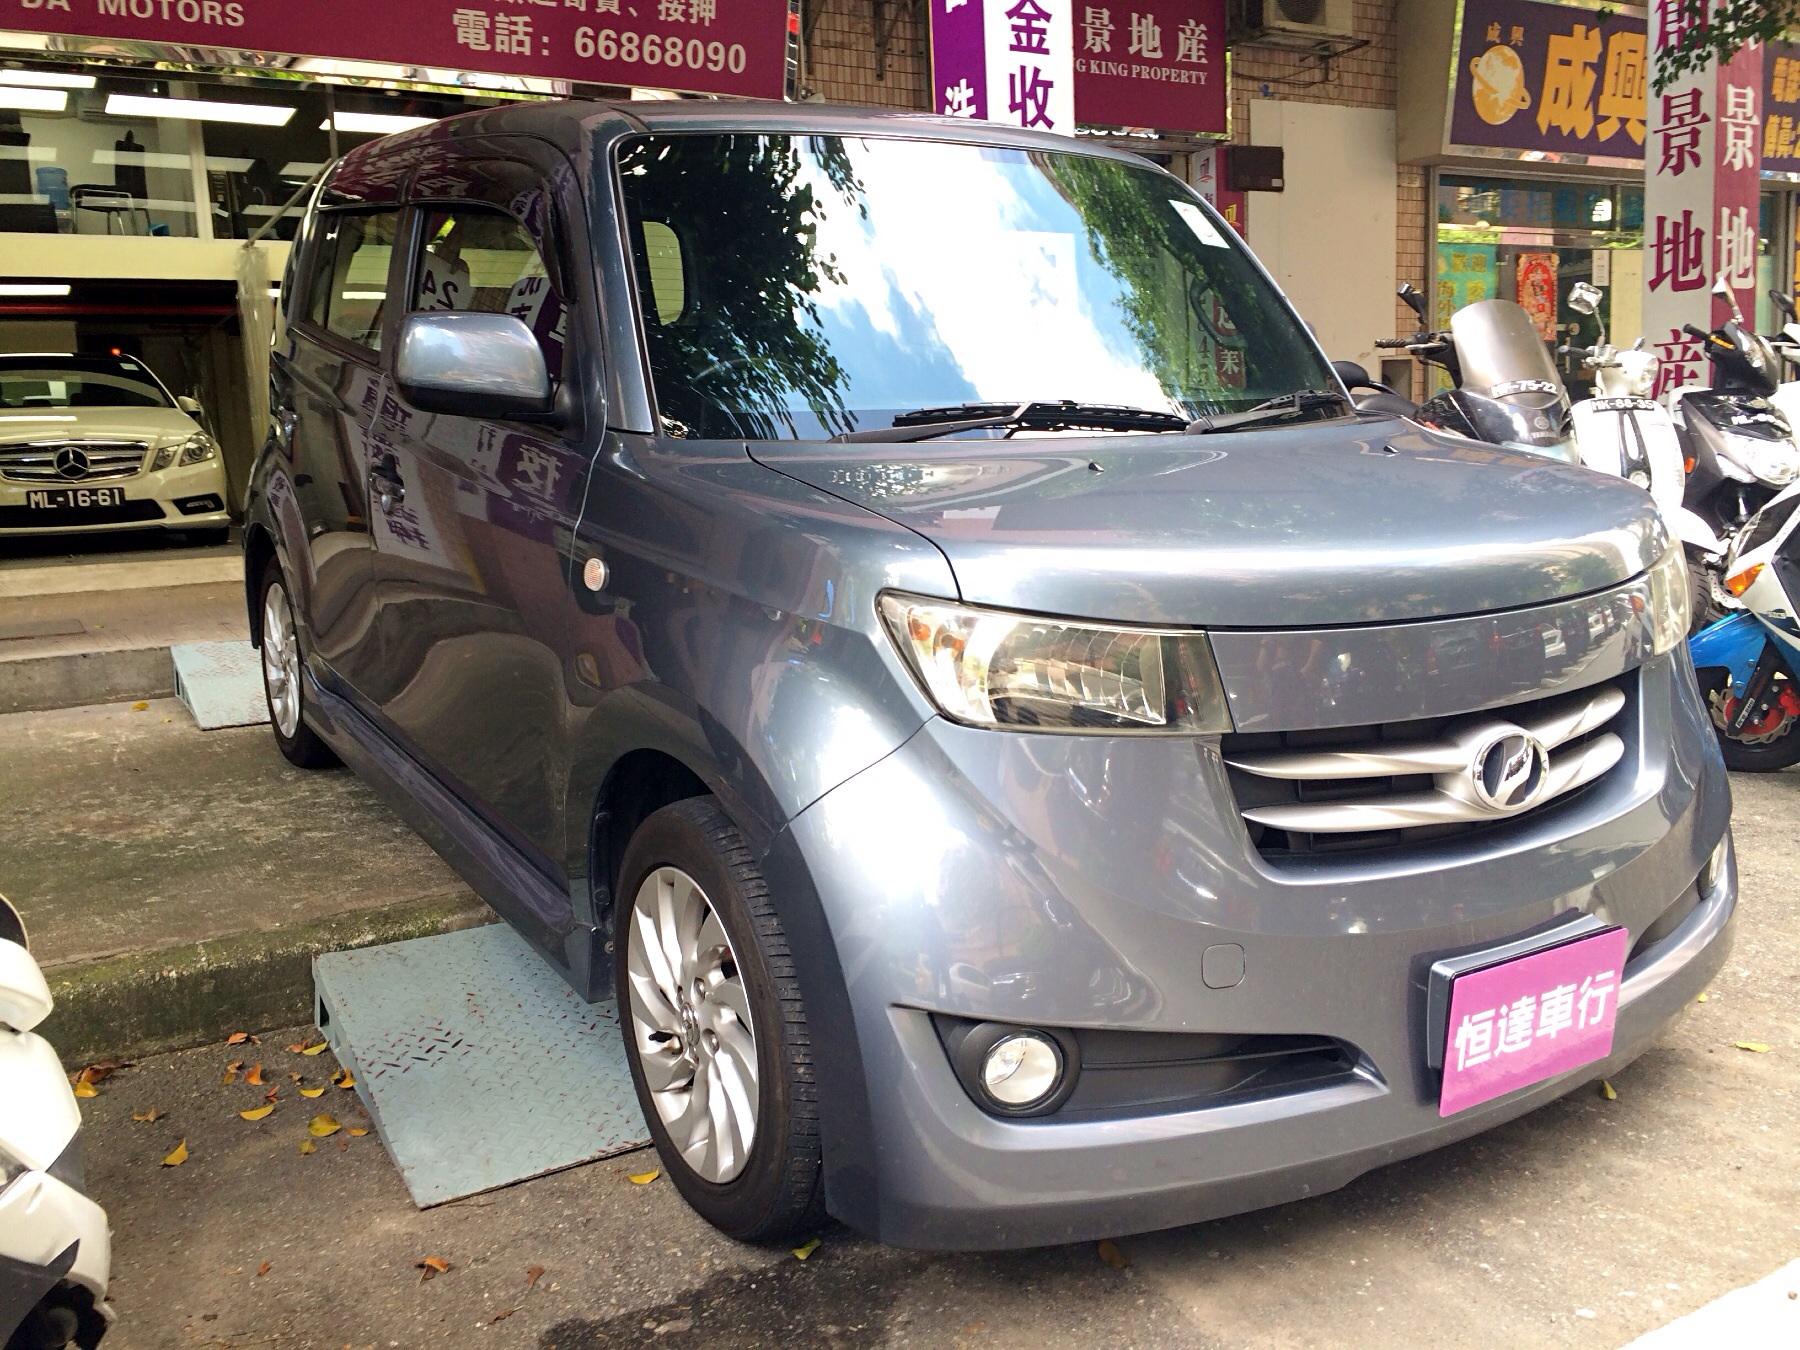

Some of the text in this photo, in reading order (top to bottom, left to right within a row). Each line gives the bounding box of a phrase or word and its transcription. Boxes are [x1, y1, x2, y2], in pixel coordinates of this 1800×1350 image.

[97, 0, 245, 27] MOTORS
[574, 26, 747, 74] 66868090
[1004, 0, 1055, 130] 金收
[1073, 57, 1208, 85] G KING PROPERTY
[29, 488, 120, 509] ML-16-61
[1454, 969, 1615, 1072] 恒達車行
